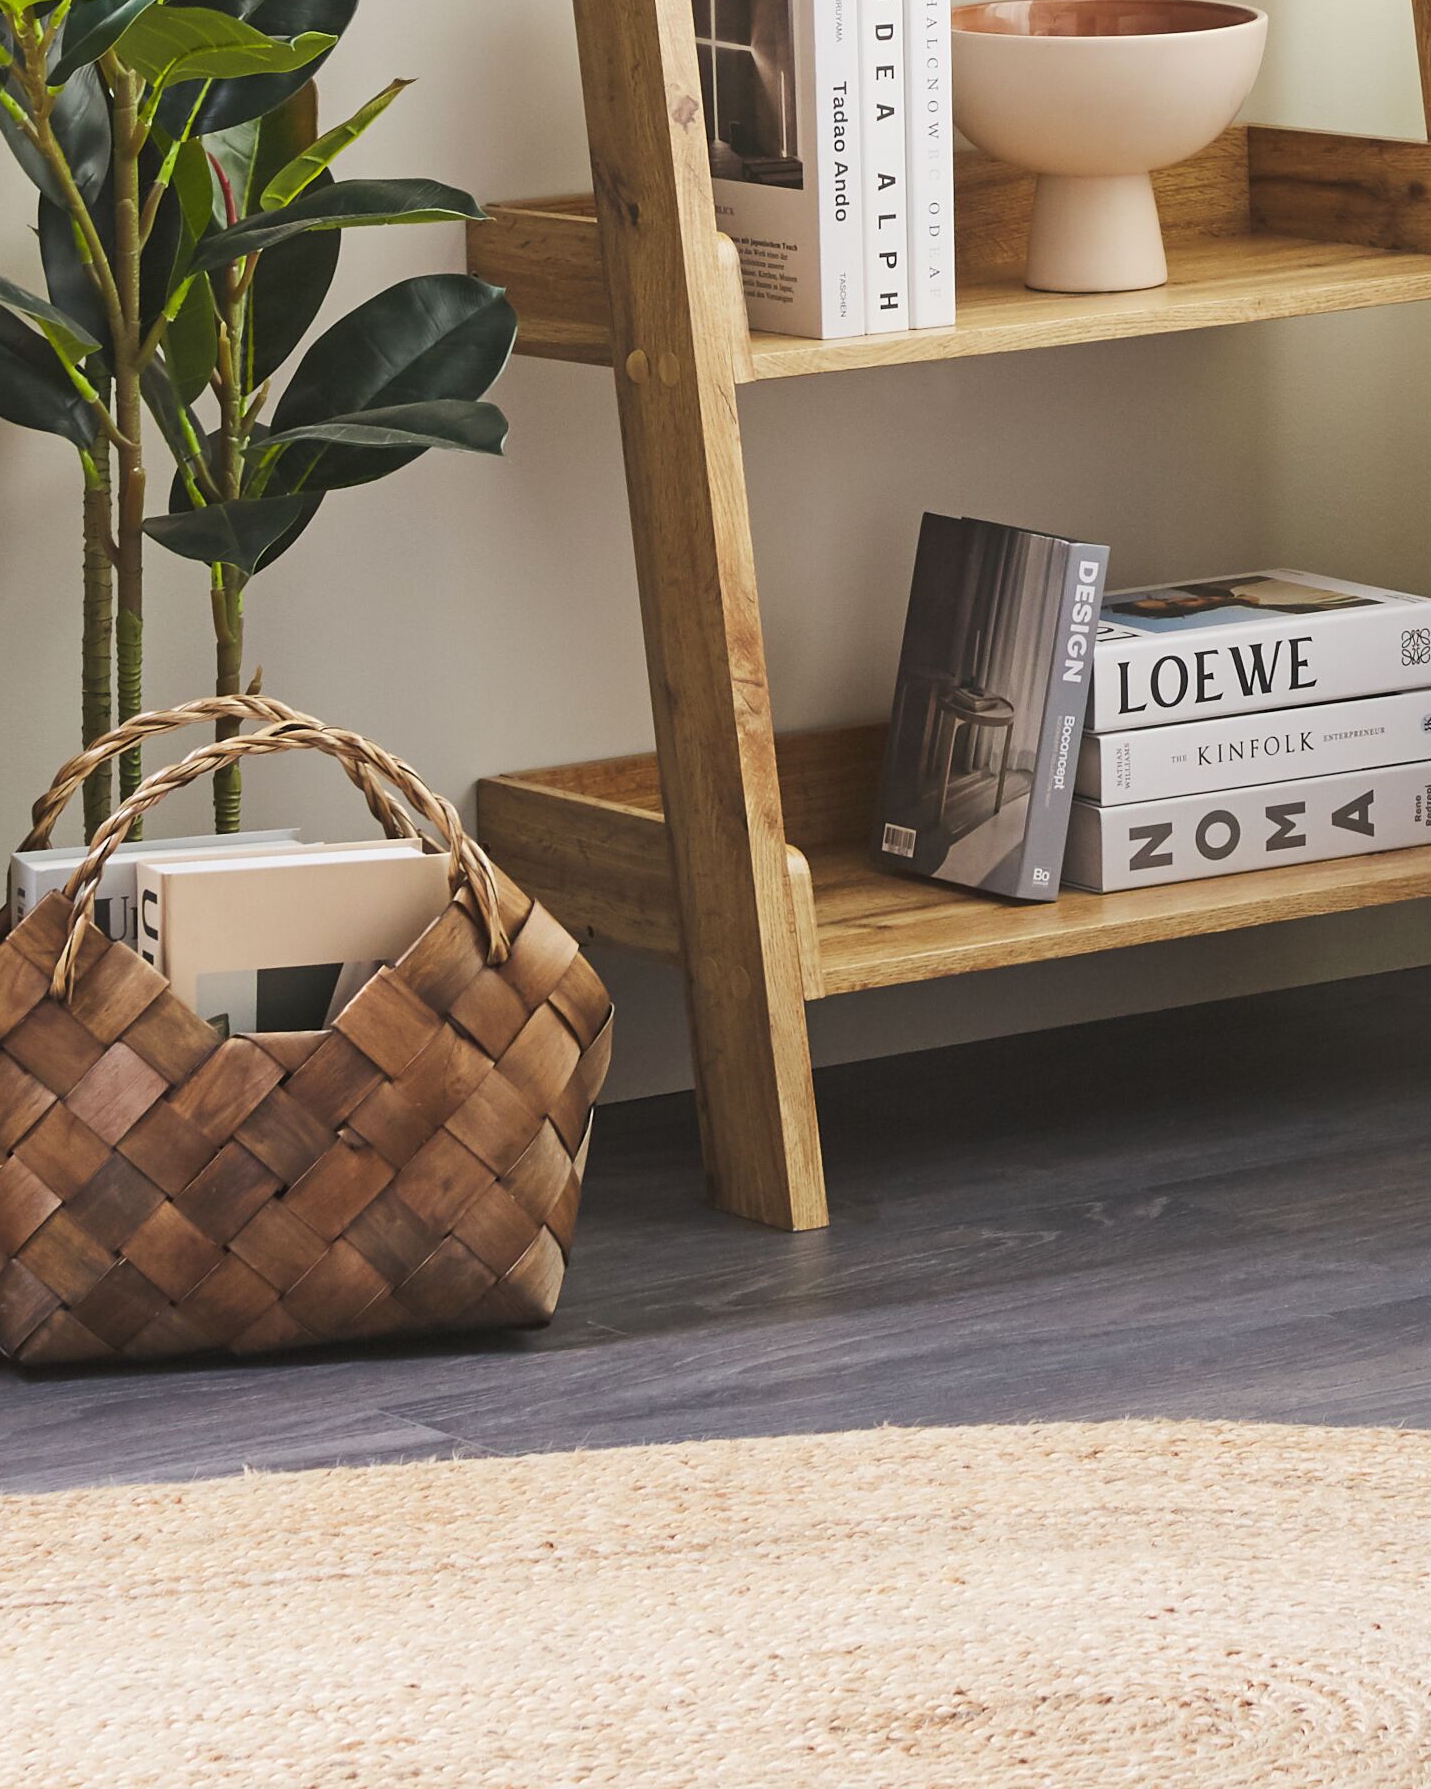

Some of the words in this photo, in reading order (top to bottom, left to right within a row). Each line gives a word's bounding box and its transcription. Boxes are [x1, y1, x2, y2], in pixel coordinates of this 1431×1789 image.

[833, 81, 848, 153] Tadao
[834, 161, 850, 222] Ando
[877, 172, 899, 310] ALPH
[839, 272, 847, 318] TASCHEN
[1062, 560, 1099, 683] DESIGN
[1118, 636, 1317, 714] LOEWE
[1053, 715, 1076, 789] Boconcept
[1116, 748, 1124, 787] NATHAN
[1171, 754, 1187, 764] THE
[1198, 731, 1315, 766] KINFOLK
[1129, 789, 1374, 871] NOMA
[1033, 867, 1050, 881] Bo
